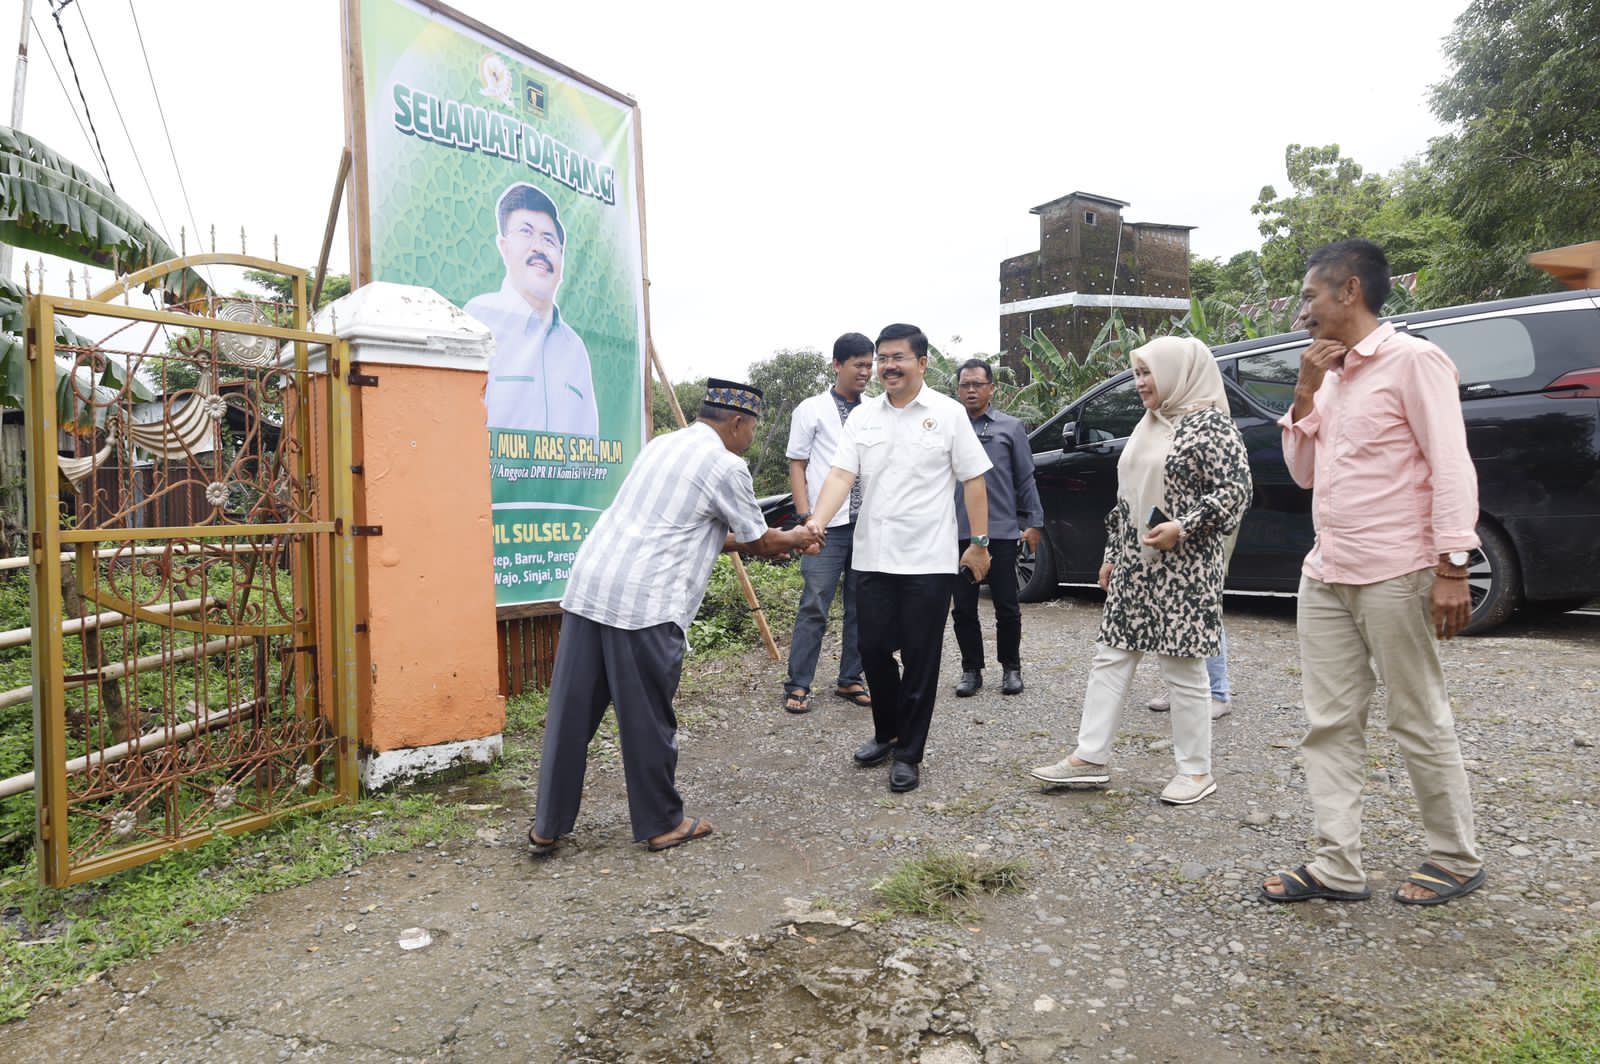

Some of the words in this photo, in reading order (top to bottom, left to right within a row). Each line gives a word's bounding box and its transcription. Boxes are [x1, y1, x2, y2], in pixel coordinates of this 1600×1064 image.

[393, 82, 521, 162] SELAMAT
[522, 125, 615, 204] DATANG
[498, 432, 530, 459] MUH.
[534, 435, 566, 464] ARAS,
[498, 463, 528, 481] Anggota
[530, 465, 546, 479] DPR
[547, 466, 557, 479] RI
[492, 524, 510, 544] IL
[512, 522, 570, 544] SULSEL
[572, 521, 582, 541] 2
[515, 553, 545, 565] Barru,
[547, 551, 576, 565] Parep
[523, 568, 553, 585] Sinjai,
